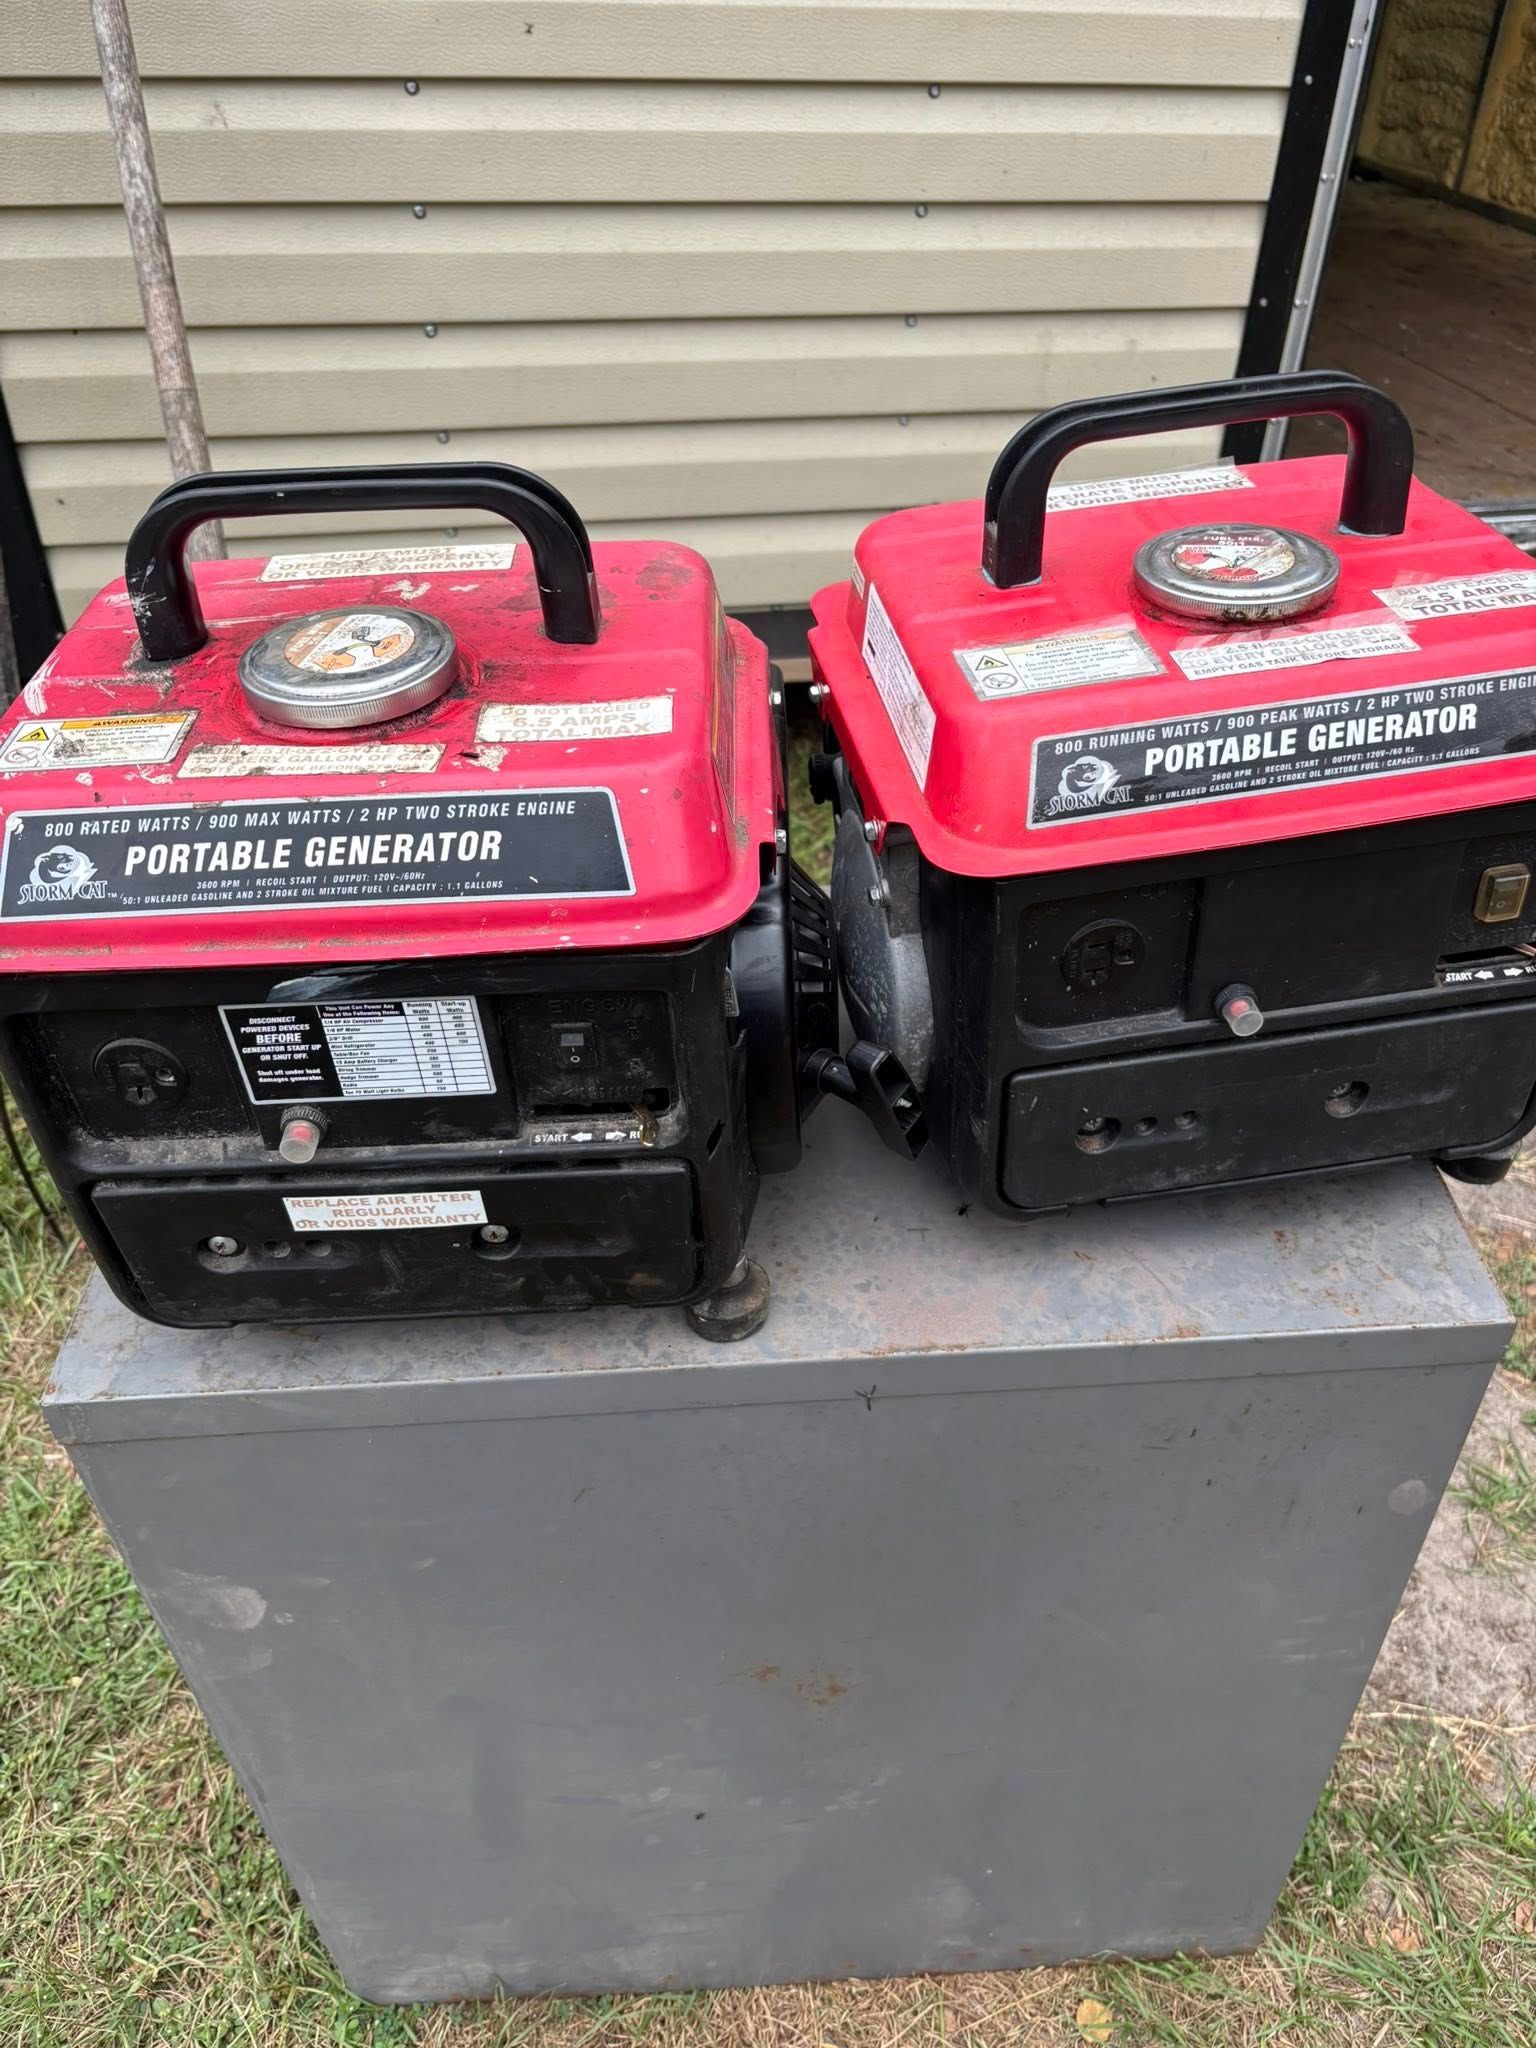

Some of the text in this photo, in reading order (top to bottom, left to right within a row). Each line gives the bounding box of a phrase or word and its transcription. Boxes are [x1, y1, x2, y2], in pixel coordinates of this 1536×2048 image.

[1069, 474, 1182, 492] USER MUST
[1129, 475, 1230, 491] PROPERLY
[1066, 480, 1244, 506] VOIDS WARRANTY
[395, 547, 456, 556] MUST
[268, 571, 298, 579] OR
[380, 560, 505, 572] WARRANTY
[1396, 574, 1529, 596] DO NOT EXCEED
[1462, 583, 1528, 598] AMPS
[1226, 644, 1248, 654] 2.5
[1361, 626, 1389, 636] OIL
[1213, 634, 1402, 665] EVERY GALLON OF GAS
[1193, 642, 1409, 676] EMPTY GAS TANK BEFORE STORAGE
[501, 702, 650, 716] DO NOT EXCEED
[99, 718, 157, 726] WARNING
[512, 712, 638, 728] 6.5 AMPS
[1054, 739, 1083, 756] 800
[1089, 728, 1156, 750] RUNNING
[1161, 720, 1209, 739] WATTS
[1227, 714, 1254, 730] 900
[1260, 707, 1298, 726] PEAK
[1303, 700, 1349, 720] WATTS
[1367, 697, 1376, 711] 2
[1381, 694, 1400, 709] HP
[1404, 689, 1435, 706] TWO
[1440, 680, 1494, 700] STROKE
[1144, 703, 1477, 776] PORTABLE GENERATOR
[288, 753, 435, 762] GALLON OF GAS
[1144, 746, 1480, 802] 50:1 UNLEADED GASOLINE AND 2 STROKE OIL MIXTURE FUEL CAPACITY 1.1 GALLONS
[1211, 753, 1364, 781] 3600 RPM RECOIL START OUTPUT:
[1046, 784, 1132, 816] STORM CAT
[44, 800, 576, 837] 800 RATED WATTS 900 MAX WATTS 2 HP TWO STROKE ENGINE
[124, 830, 503, 876] PORTABLE GENERATOR
[196, 880, 218, 890] 3600
[220, 879, 241, 888] RPM
[255, 877, 286, 887] RECOIL
[289, 876, 318, 885] START
[333, 874, 370, 883] OUTPUT:
[17, 880, 108, 905] STORM CAT
[122, 880, 503, 905] 50:1 UNLEADED GASOLINE AND 2 STROKE OIL MIXTURE FUEL CAPACITY 1.1 GALLONS
[1445, 971, 1473, 982] START
[240, 1024, 310, 1034] POWERED DEVICES
[249, 1016, 296, 1025] DISCONNECT
[256, 1033, 302, 1044] BEFORE
[242, 1045, 285, 1054] GENERATOR
[286, 1044, 309, 1052] START
[260, 1054, 271, 1062] OR
[272, 1053, 292, 1061] SHUT
[534, 1133, 569, 1143] START
[290, 1192, 473, 1208] REPLACE AIR FILTER
[332, 1205, 436, 1218] REGULARLY
[295, 1212, 482, 1230] OR VOIDS WARRANTY
